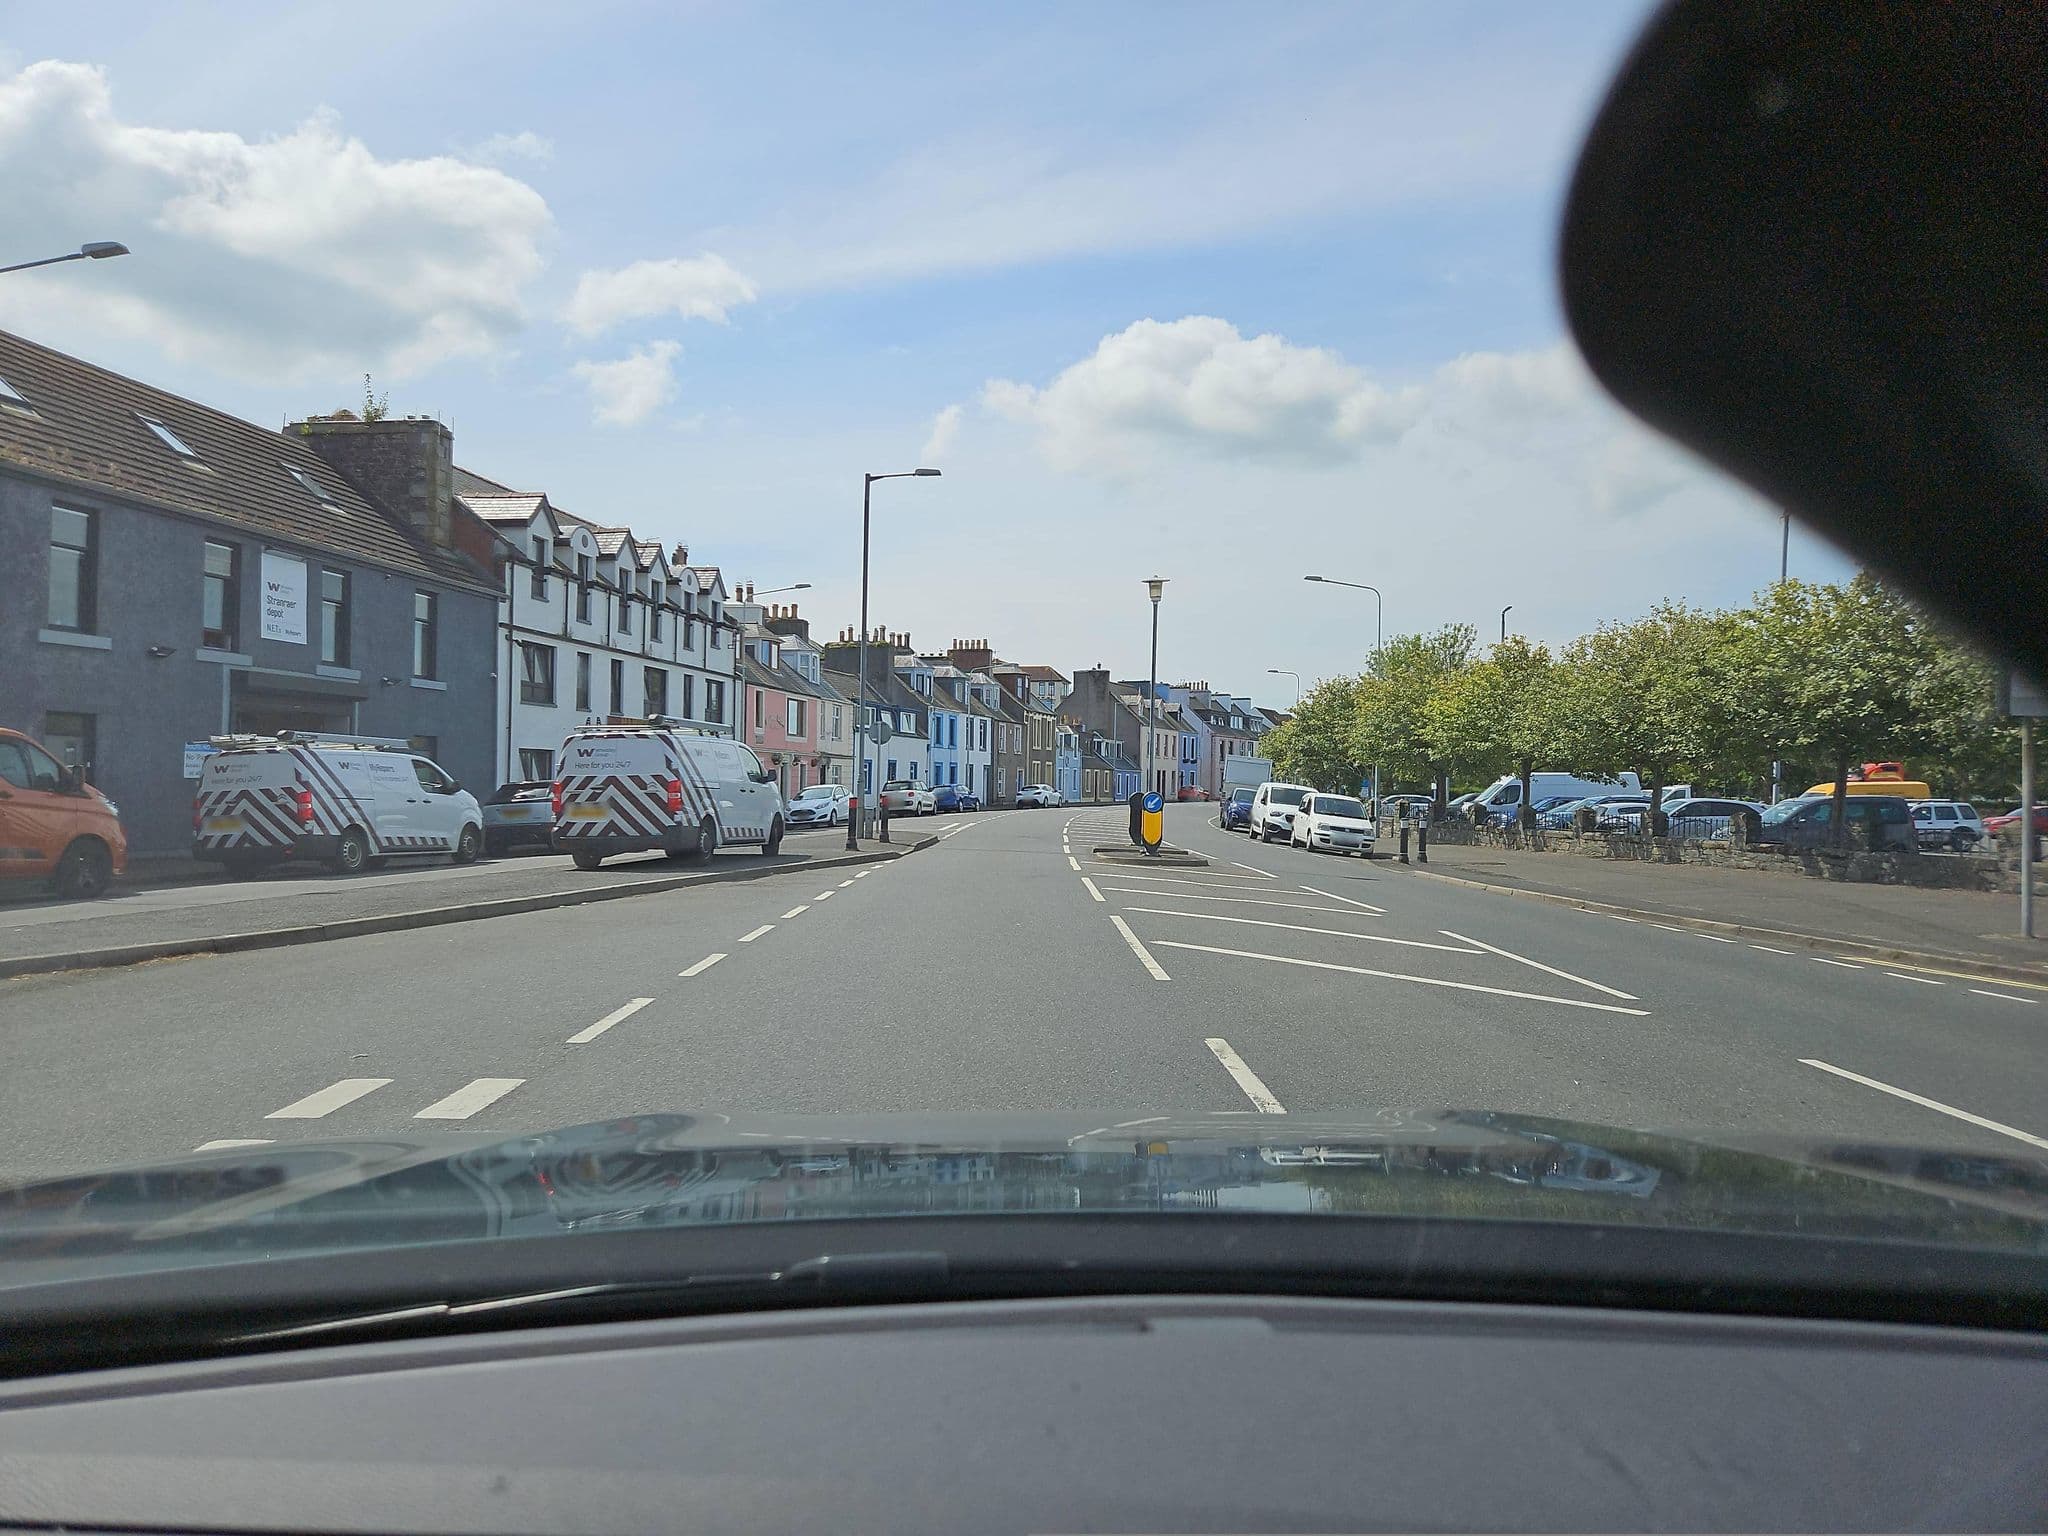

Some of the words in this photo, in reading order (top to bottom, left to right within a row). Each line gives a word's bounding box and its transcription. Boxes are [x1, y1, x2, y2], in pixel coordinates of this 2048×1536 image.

[267, 581, 281, 592] W
[266, 595, 297, 609] Stranraer
[266, 607, 284, 619] depot
[576, 748, 595, 758] W
